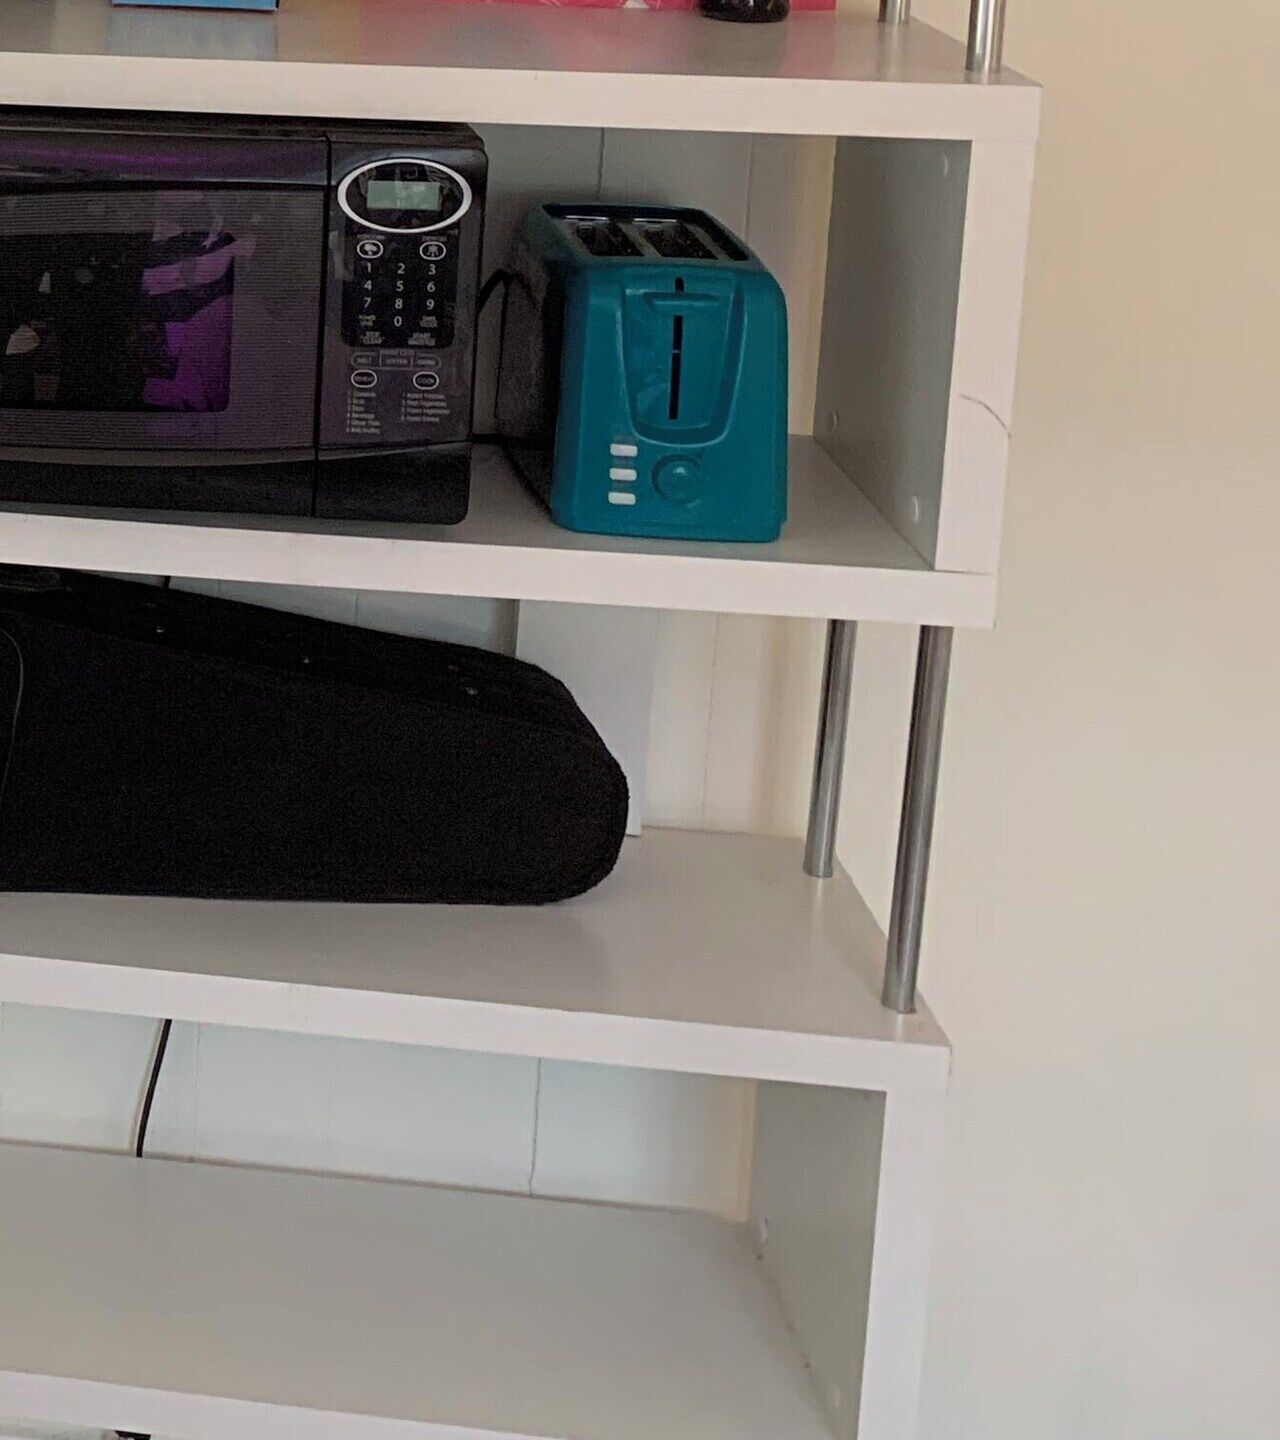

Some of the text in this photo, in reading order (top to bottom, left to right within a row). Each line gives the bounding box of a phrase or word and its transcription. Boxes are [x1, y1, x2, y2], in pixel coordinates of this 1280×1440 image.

[397, 263, 405, 274] 2
[428, 264, 436, 275] 3
[364, 280, 372, 291] 4
[396, 280, 403, 291] 5
[427, 281, 436, 292] 6
[364, 297, 371, 308] 7
[395, 298, 403, 309] 8
[426, 299, 434, 310] 9
[394, 316, 402, 327] 0
